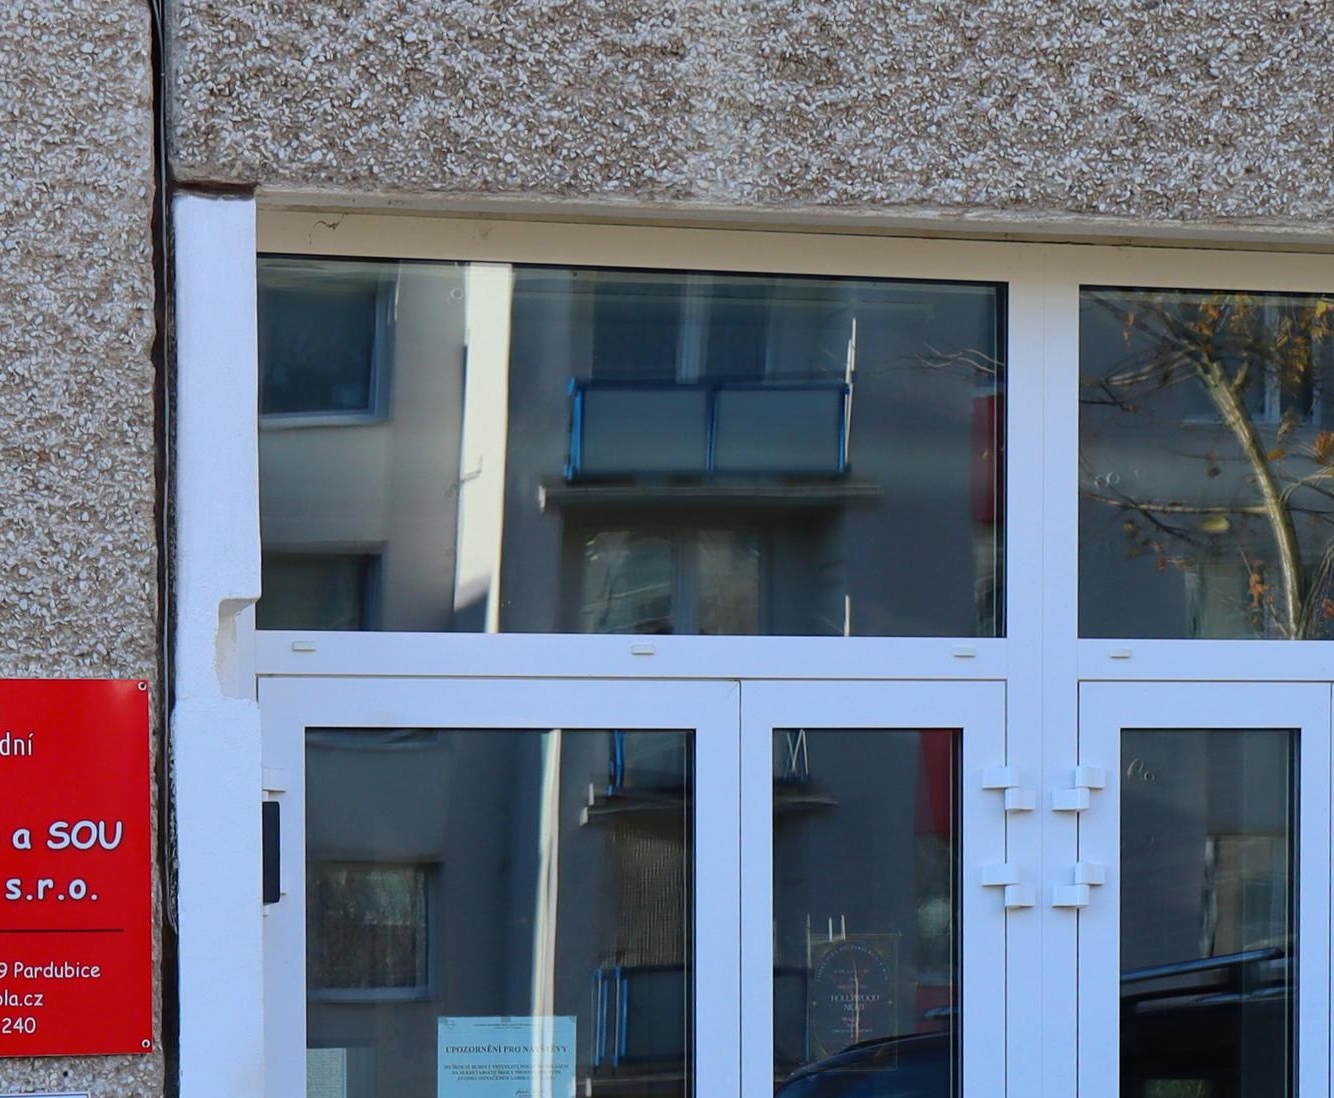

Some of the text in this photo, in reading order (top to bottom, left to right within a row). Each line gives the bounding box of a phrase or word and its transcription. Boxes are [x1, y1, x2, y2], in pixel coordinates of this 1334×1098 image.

[12, 827, 32, 850] a
[46, 819, 123, 850] SOU
[5, 877, 98, 901] s.r.o.
[14, 961, 102, 980] Pardubice
[1, 1016, 37, 1034] 240
[503, 1045, 521, 1053] PRO
